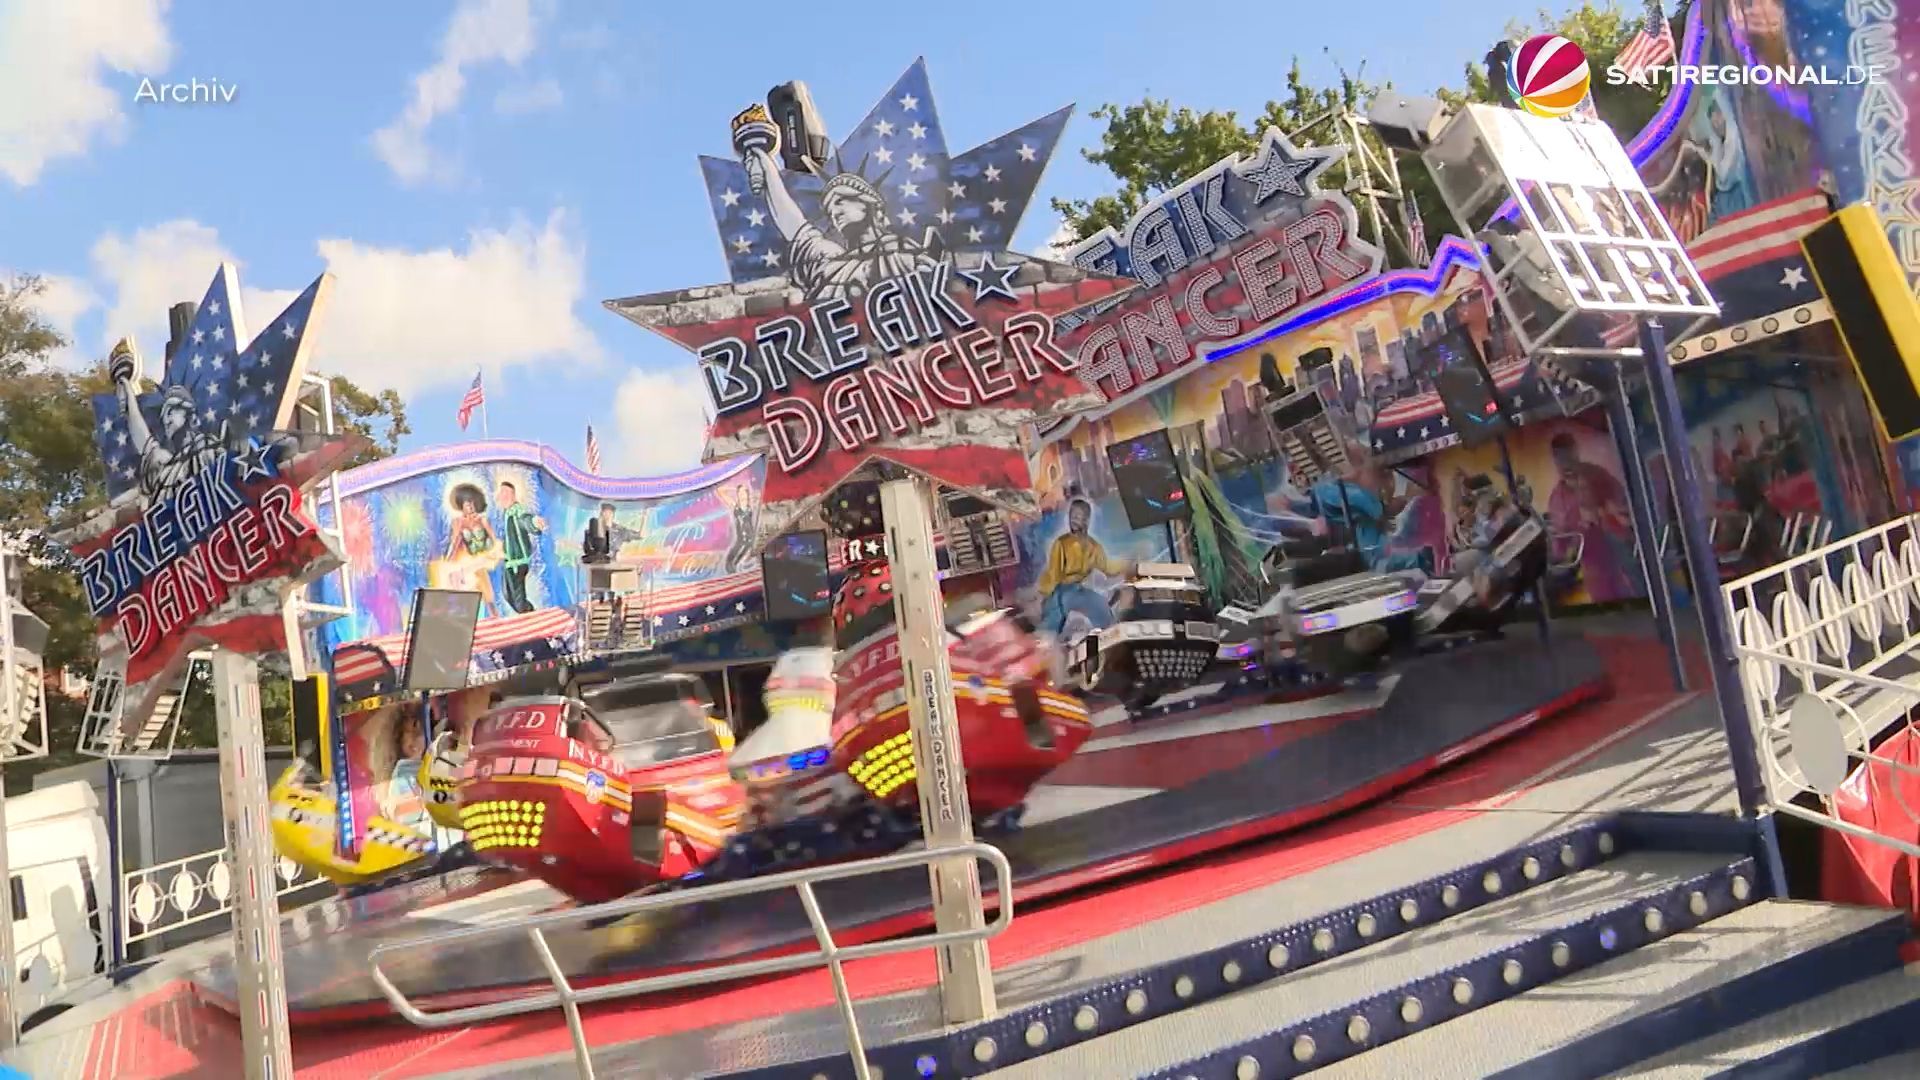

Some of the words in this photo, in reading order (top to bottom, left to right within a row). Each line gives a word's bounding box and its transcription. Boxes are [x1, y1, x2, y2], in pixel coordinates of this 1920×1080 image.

[700, 260, 977, 415] BREAK
[1078, 208, 1367, 403] ANCER
[762, 311, 1080, 473] DANCER
[80, 452, 243, 617] BREAK
[117, 483, 308, 658] DANCER
